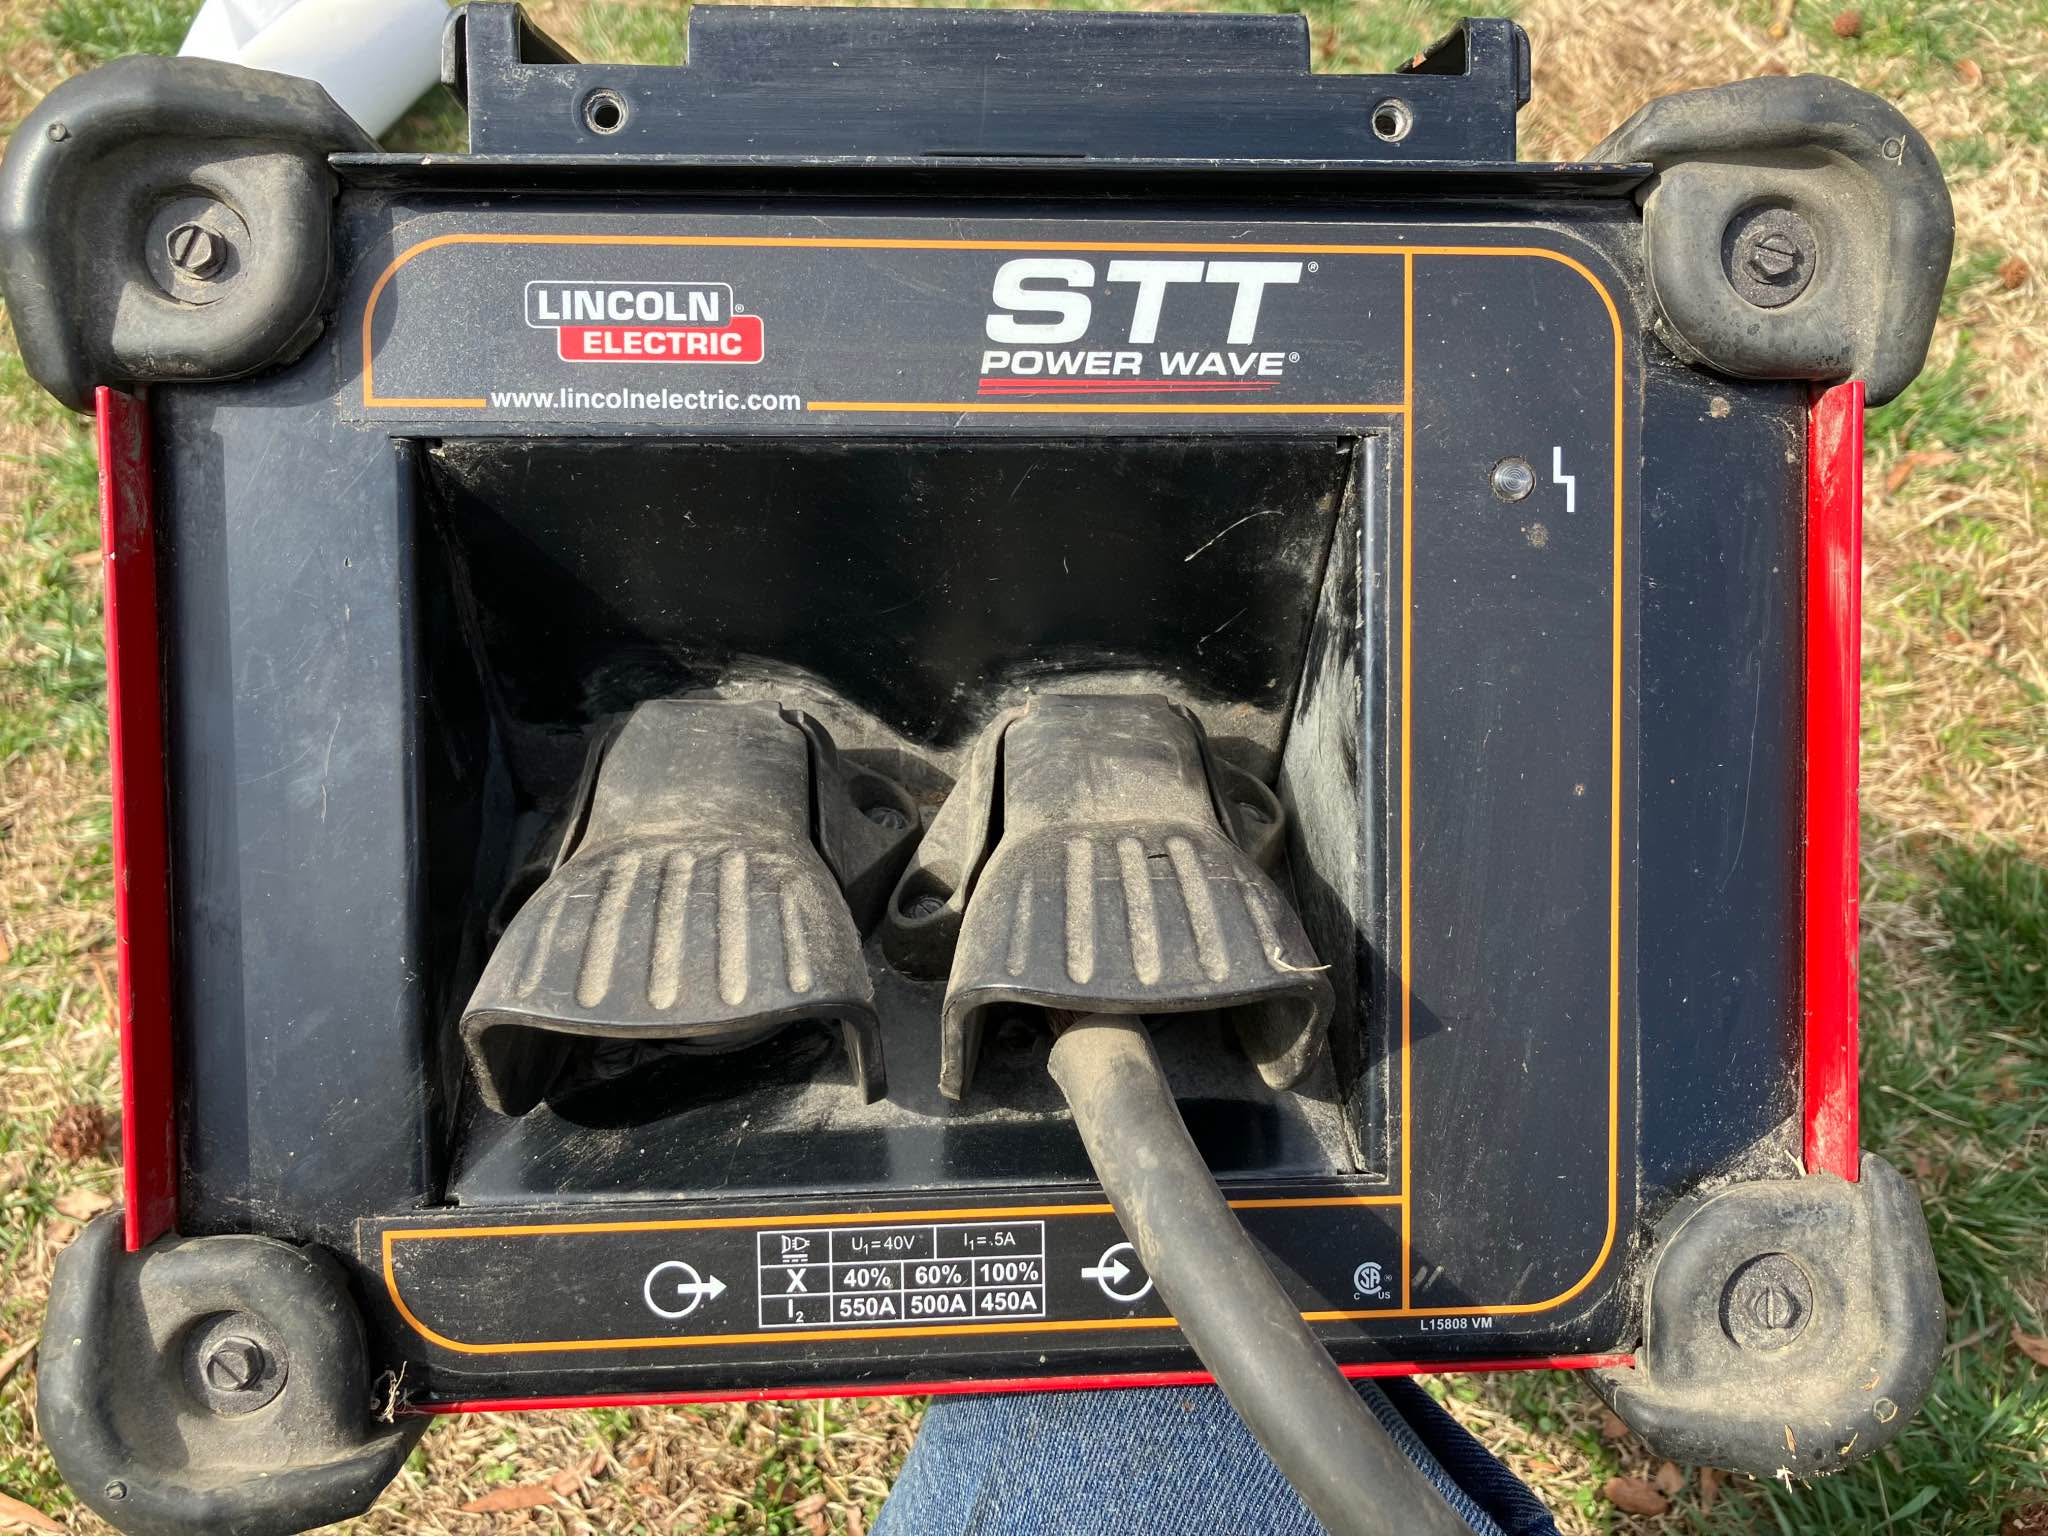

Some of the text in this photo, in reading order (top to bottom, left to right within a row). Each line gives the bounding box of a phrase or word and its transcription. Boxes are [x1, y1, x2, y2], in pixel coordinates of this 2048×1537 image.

[538, 289, 720, 322] LINCOLN
[985, 258, 1303, 345] STT
[583, 331, 742, 355] ELECTRIC
[980, 350, 1286, 376] POWER WAVE
[490, 387, 801, 411] www.lincolnelectric.com
[786, 1261, 1039, 1293] X 40% 60% 100%
[839, 1296, 897, 1317] 550A
[911, 1293, 967, 1314] 500A
[980, 1290, 1038, 1311] 450A
[1378, 1291, 1391, 1300] US
[1420, 1317, 1493, 1331] L15808 VM
